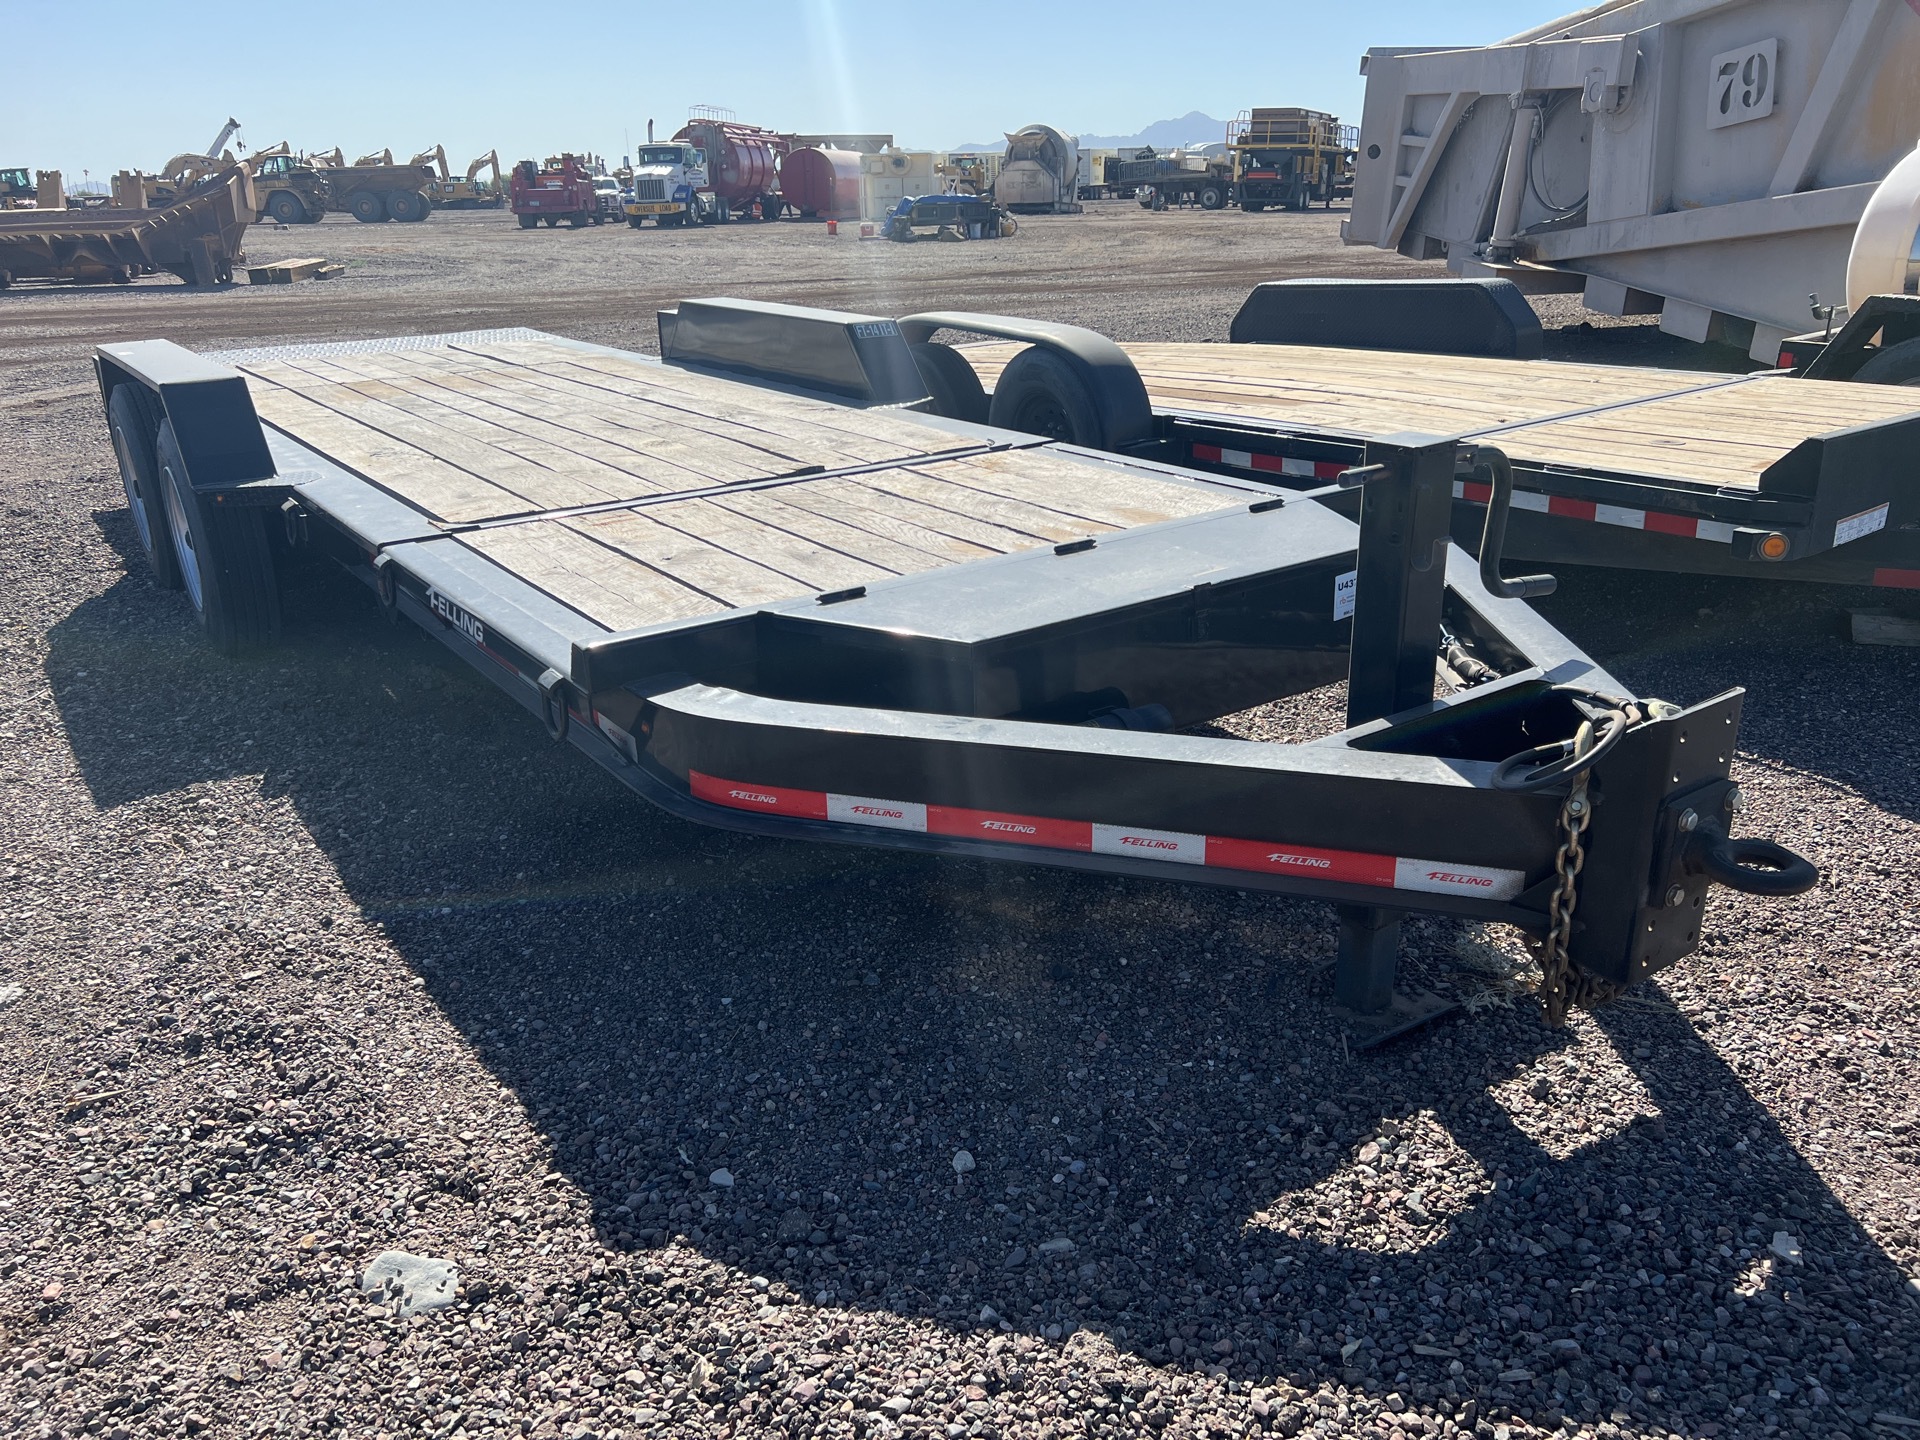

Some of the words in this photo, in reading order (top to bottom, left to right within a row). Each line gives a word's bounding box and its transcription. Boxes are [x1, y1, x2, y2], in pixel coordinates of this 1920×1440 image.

[1717, 53, 1768, 114] 79
[634, 205, 655, 213] OVERSIZE
[659, 204, 671, 212] LOAD
[425, 585, 485, 643] FELLING
[728, 790, 777, 804] FELLING
[851, 805, 903, 819] FELLING
[980, 820, 1036, 834] FELLING
[1119, 837, 1178, 851] FELLING
[1266, 853, 1331, 868] FELLING
[1426, 872, 1493, 887] FELLING
